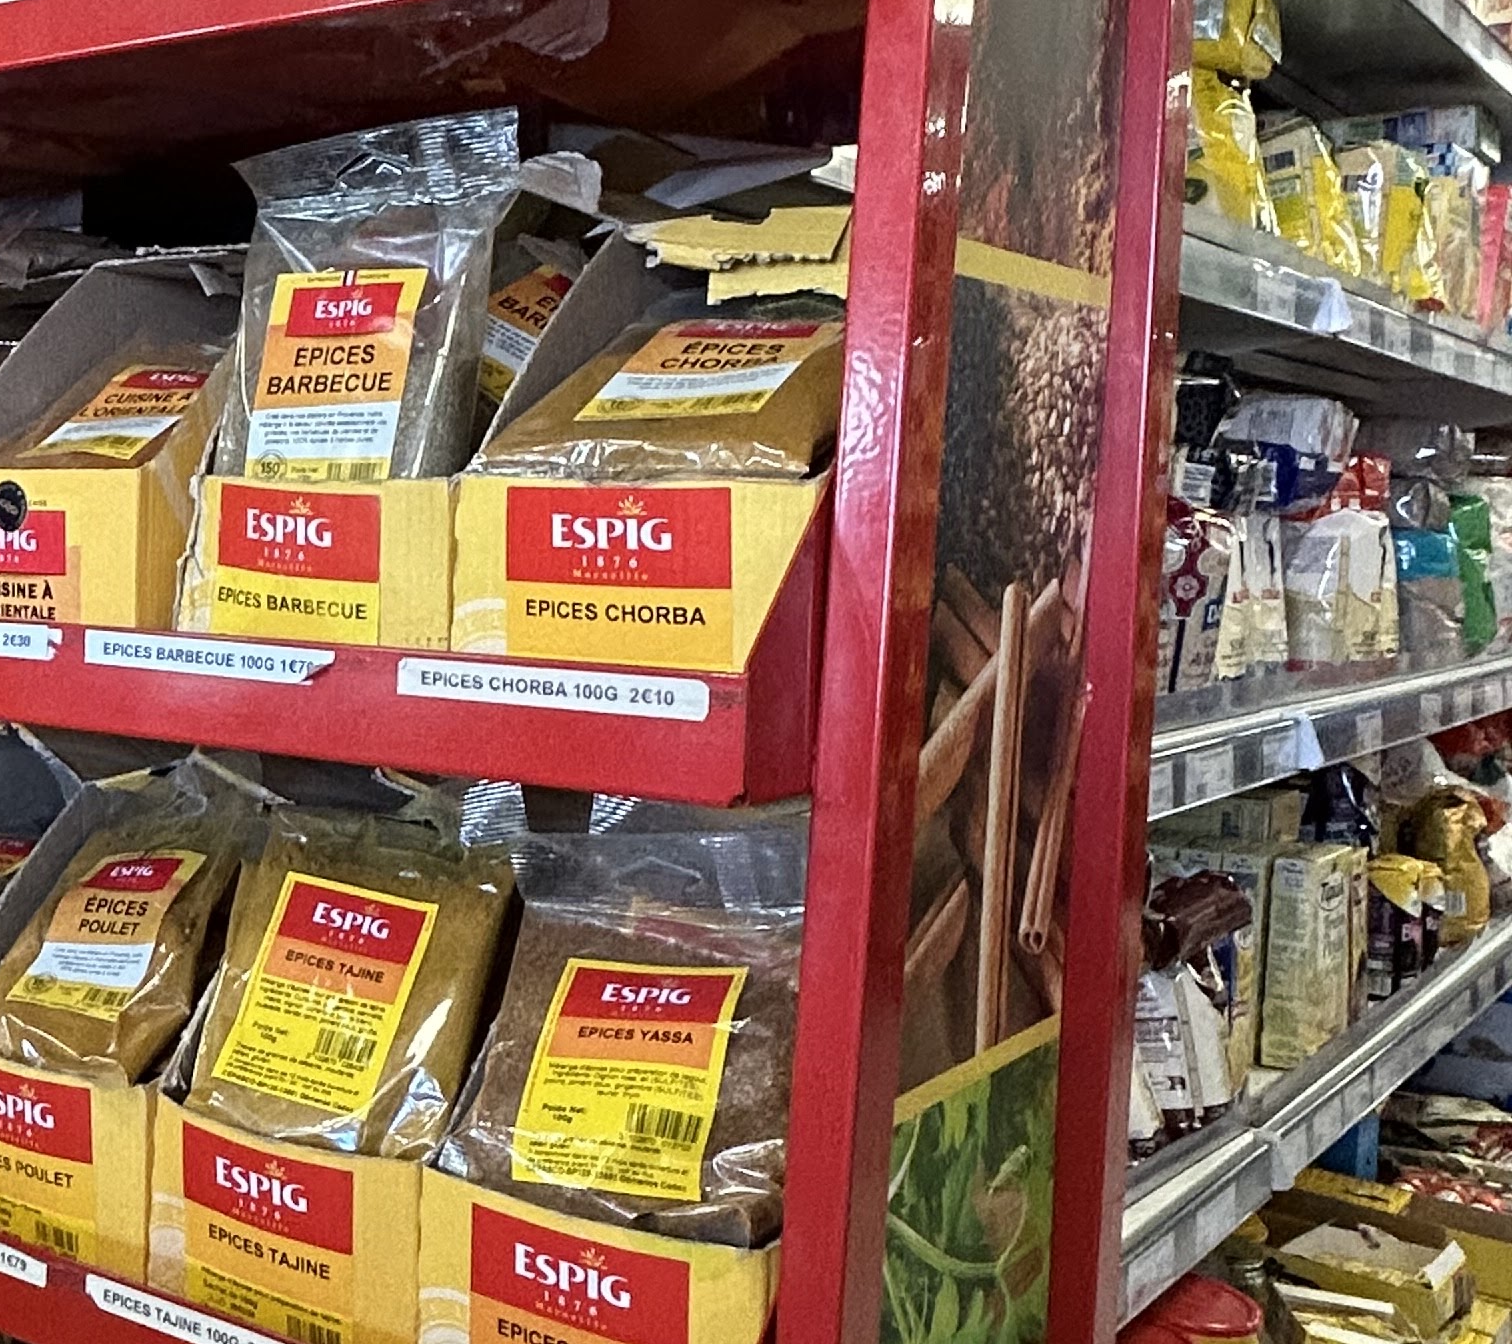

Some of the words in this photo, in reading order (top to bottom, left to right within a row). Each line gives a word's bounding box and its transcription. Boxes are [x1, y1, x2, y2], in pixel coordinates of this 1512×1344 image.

[313, 297, 373, 320] ESPIG
[265, 371, 394, 396] BARBECUE
[246, 507, 333, 548] ESPIG
[550, 512, 673, 554] ESPIG
[580, 554, 641, 570] 1876
[41, 575, 55, 601] À
[217, 586, 262, 608] EPICES
[265, 593, 369, 621] BARBECUE
[524, 597, 598, 623] EPICES
[604, 601, 707, 628] CHORBA
[102, 640, 153, 661] EPICES
[155, 646, 236, 669] BARBECUE
[240, 653, 276, 673] 100G
[420, 669, 484, 693] EPICES
[488, 673, 568, 699] CHORBA
[572, 680, 619, 703] 100G
[628, 686, 676, 708] 2€10
[110, 863, 155, 880] ESPIG
[77, 918, 140, 938] POULET
[312, 901, 391, 940] ESPIG
[285, 948, 336, 972] EPICES
[338, 962, 386, 984] TAJINE
[601, 982, 692, 1006] ESPIG
[578, 1026, 635, 1042] EPICES
[640, 1028, 695, 1045] YASSA
[15, 1162, 74, 1189] POULET
[215, 1155, 309, 1214] ESPIG
[207, 1223, 264, 1259] EPICES
[267, 1246, 332, 1281] TAJINE
[514, 1241, 632, 1310] ESPIG
[103, 1289, 152, 1319] EPICES
[154, 1306, 202, 1337] TAJINE
